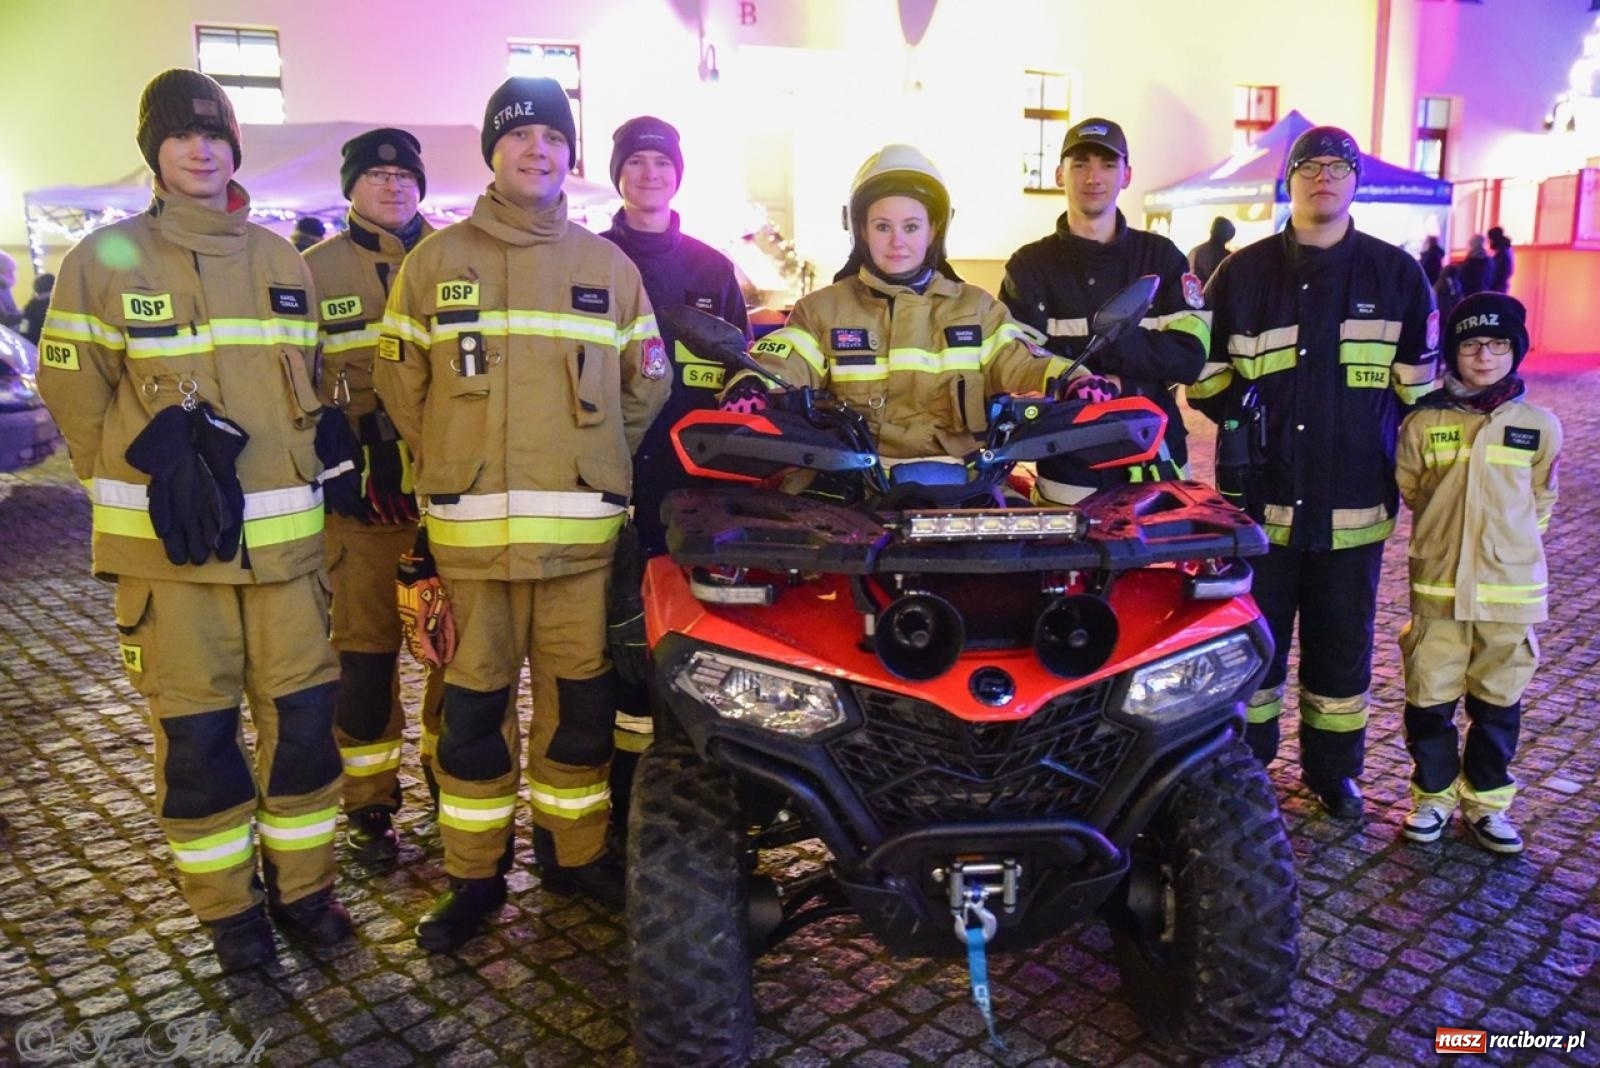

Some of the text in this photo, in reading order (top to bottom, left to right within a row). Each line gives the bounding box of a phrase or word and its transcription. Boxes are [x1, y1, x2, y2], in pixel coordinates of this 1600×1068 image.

[442, 284, 473, 301] OSP
[130, 298, 165, 316] OSP
[327, 300, 356, 316] OSP
[45, 344, 71, 364] OSP
[756, 342, 786, 353] OSP
